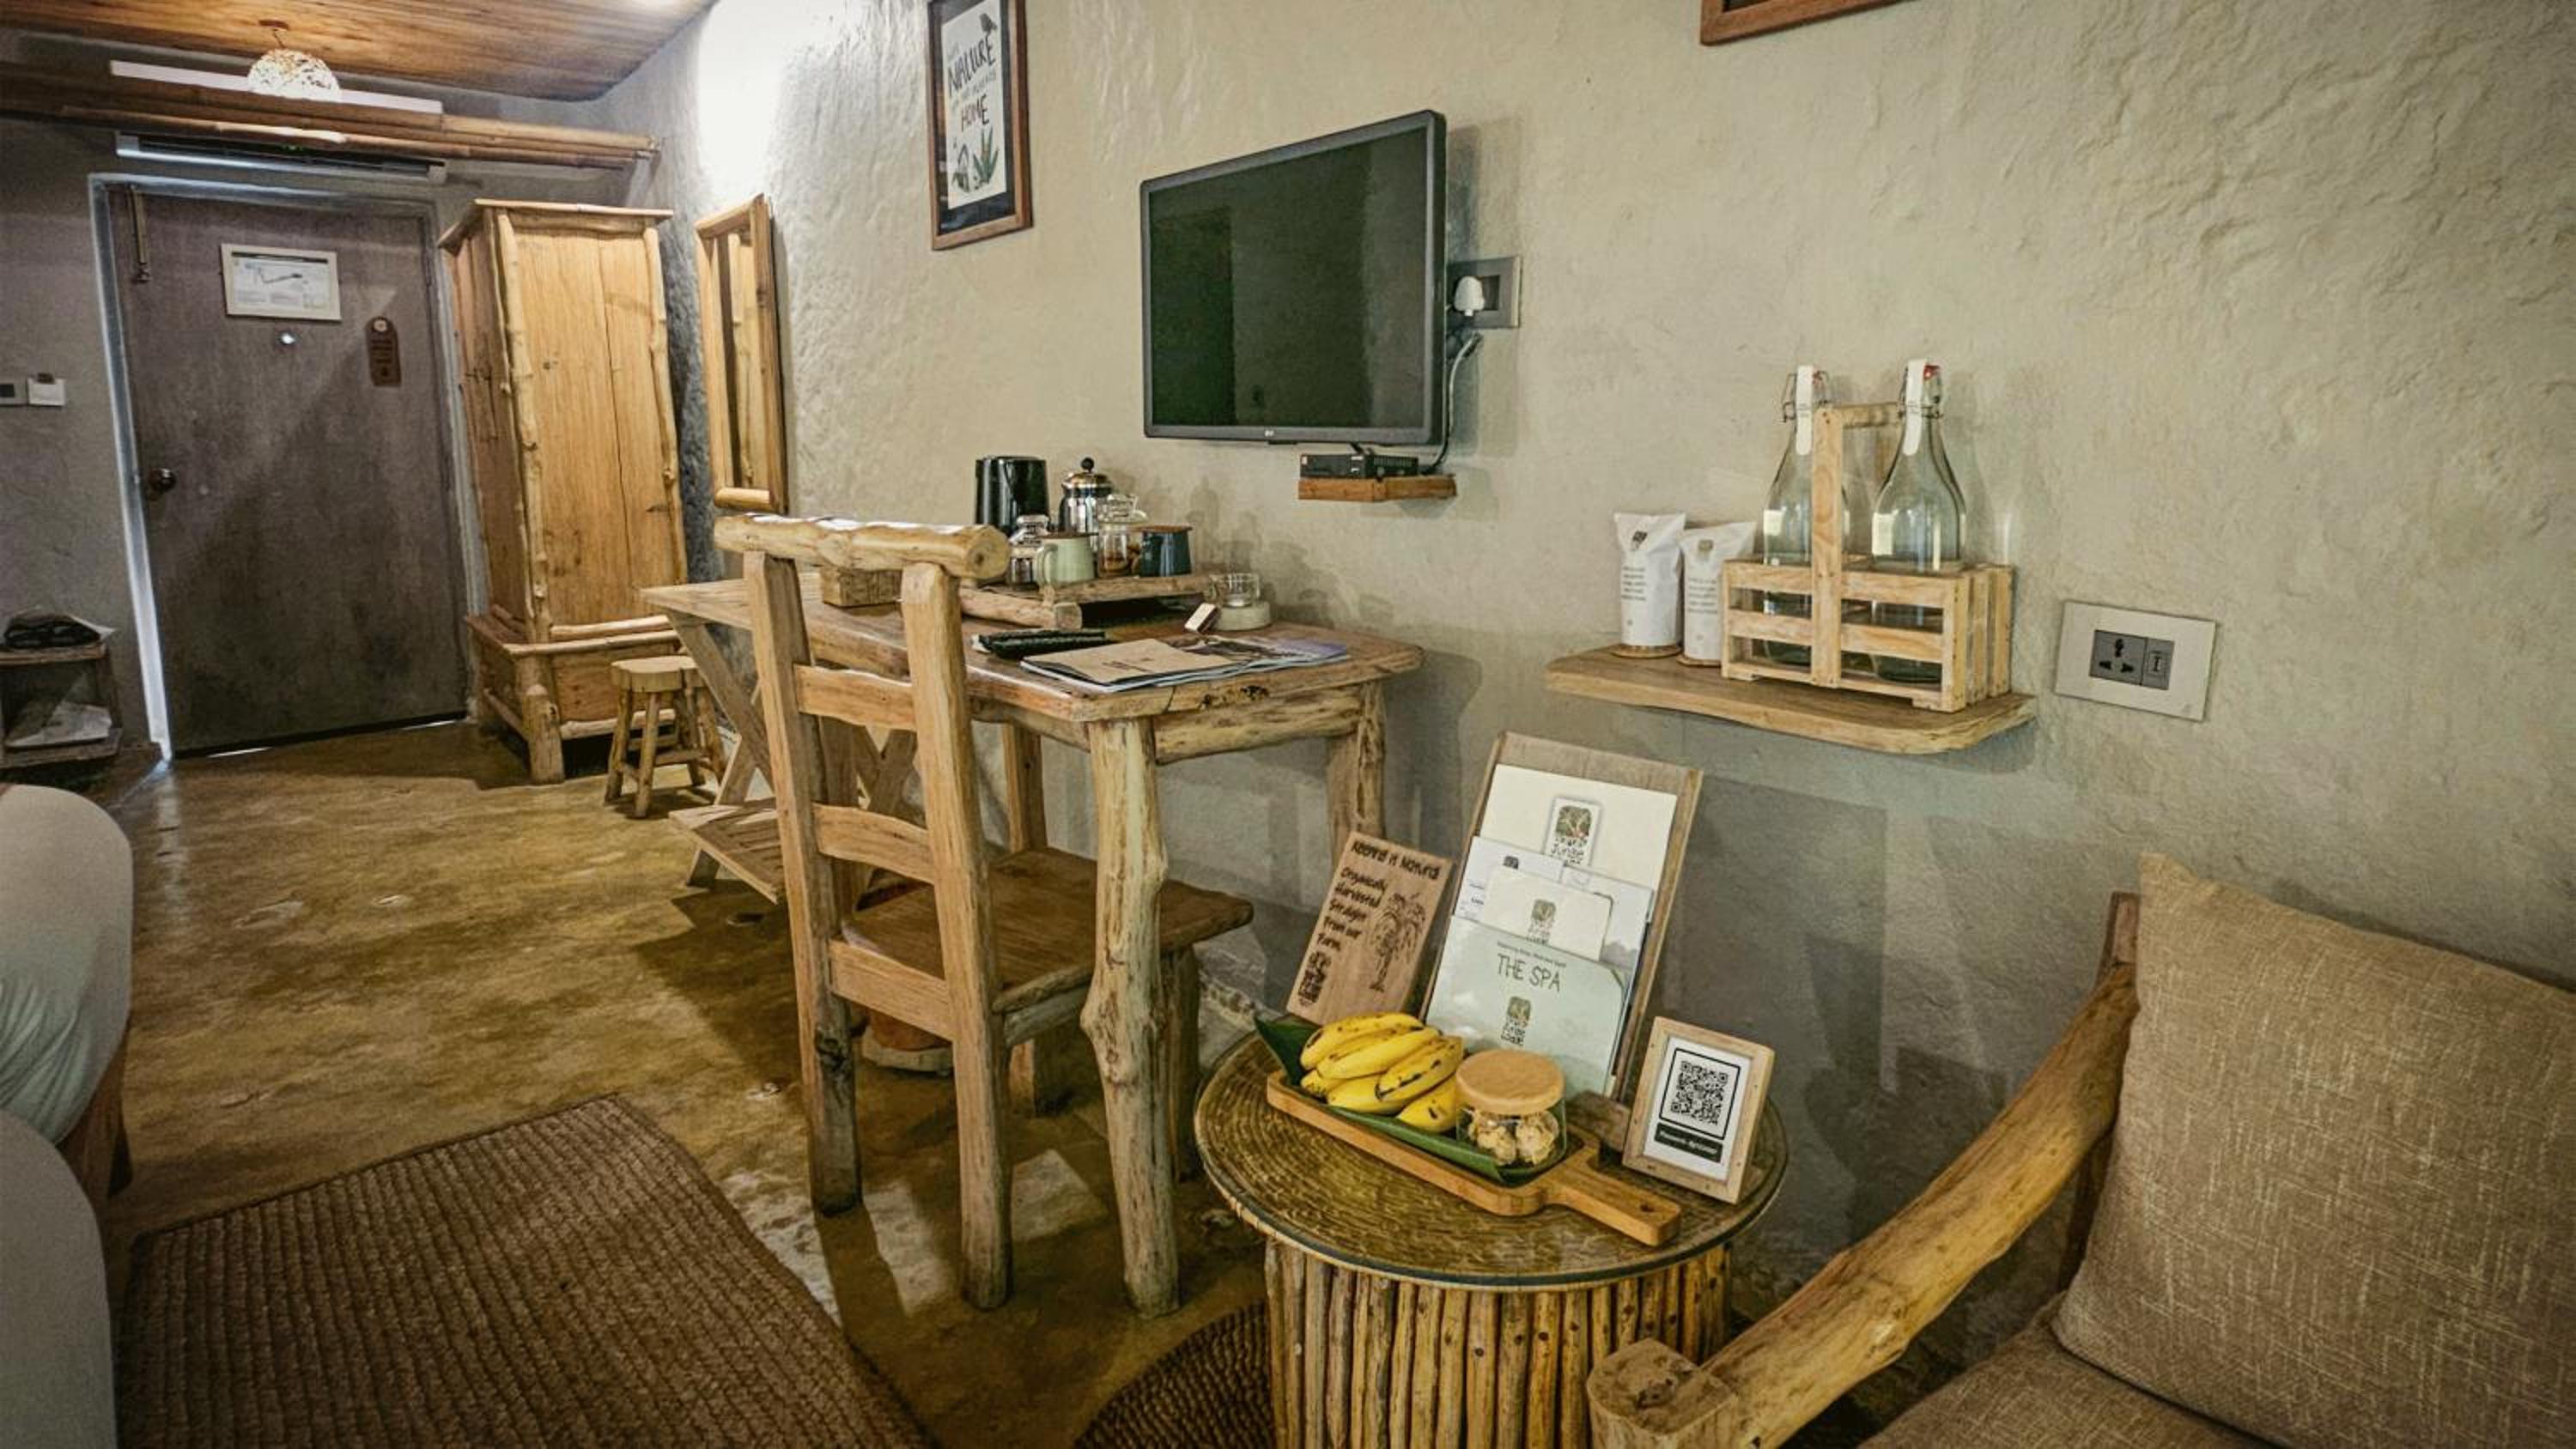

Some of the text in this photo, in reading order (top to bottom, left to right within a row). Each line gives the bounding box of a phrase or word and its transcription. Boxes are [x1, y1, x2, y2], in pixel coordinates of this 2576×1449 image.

[961, 93, 990, 133] HOME
[1497, 953, 1526, 980] THE
[1528, 965, 1560, 993] SPA
